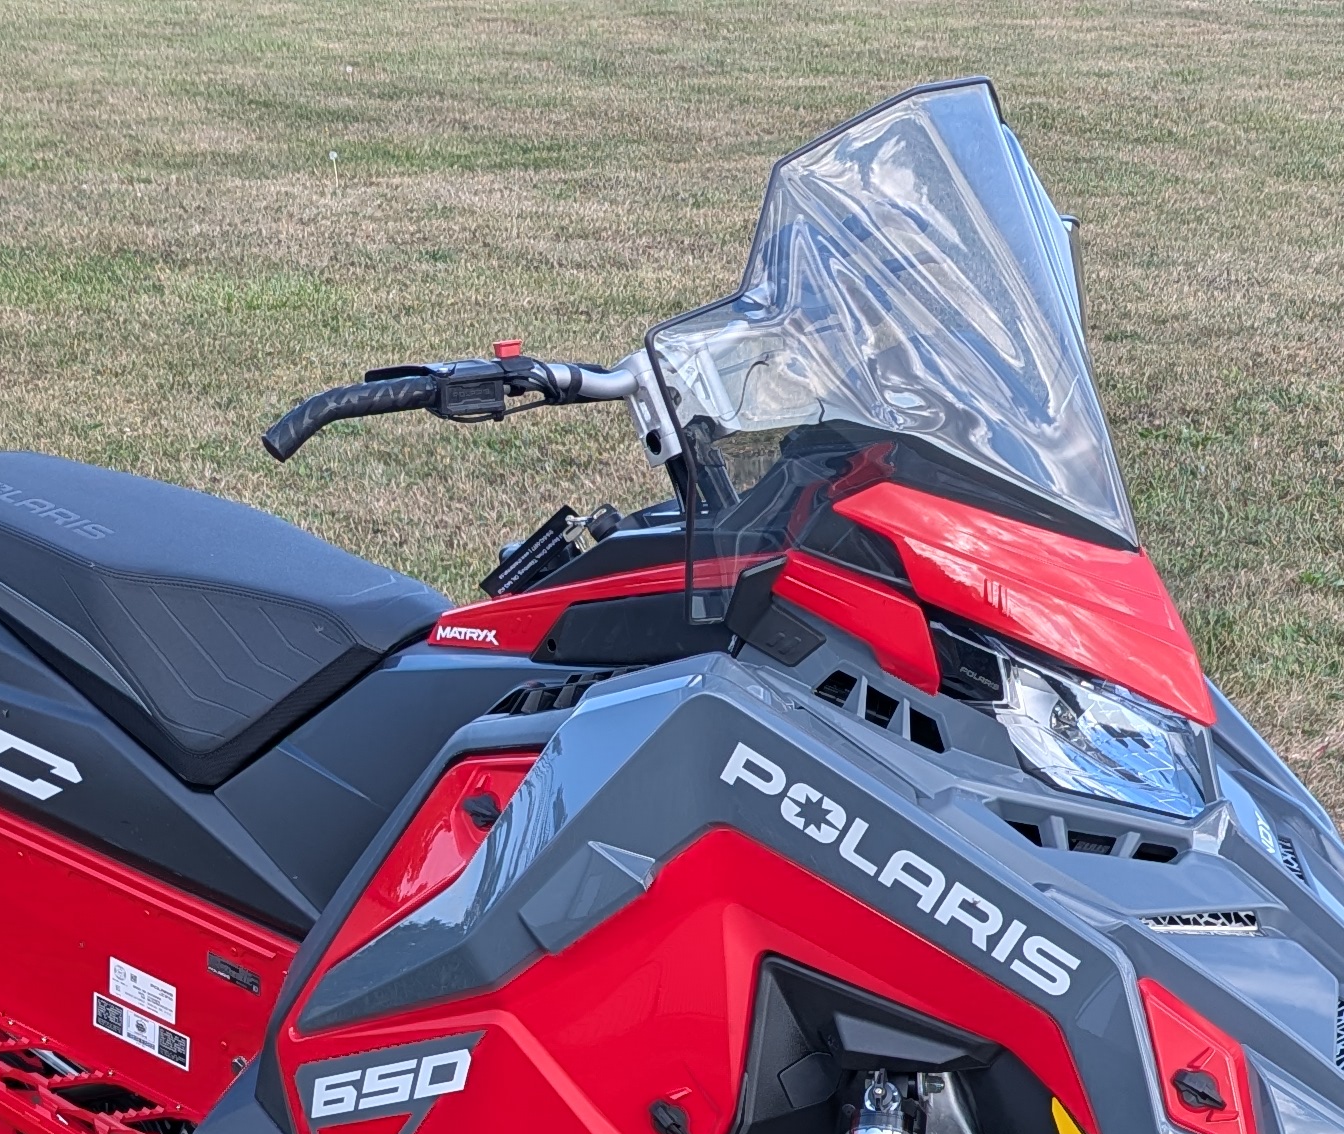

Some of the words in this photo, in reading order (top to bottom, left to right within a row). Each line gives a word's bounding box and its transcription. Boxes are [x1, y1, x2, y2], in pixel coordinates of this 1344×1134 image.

[436, 625, 499, 645] MATRYX
[960, 666, 999, 690] POLARIS
[720, 742, 1081, 996] POLARIS
[311, 1049, 472, 1118] 650
